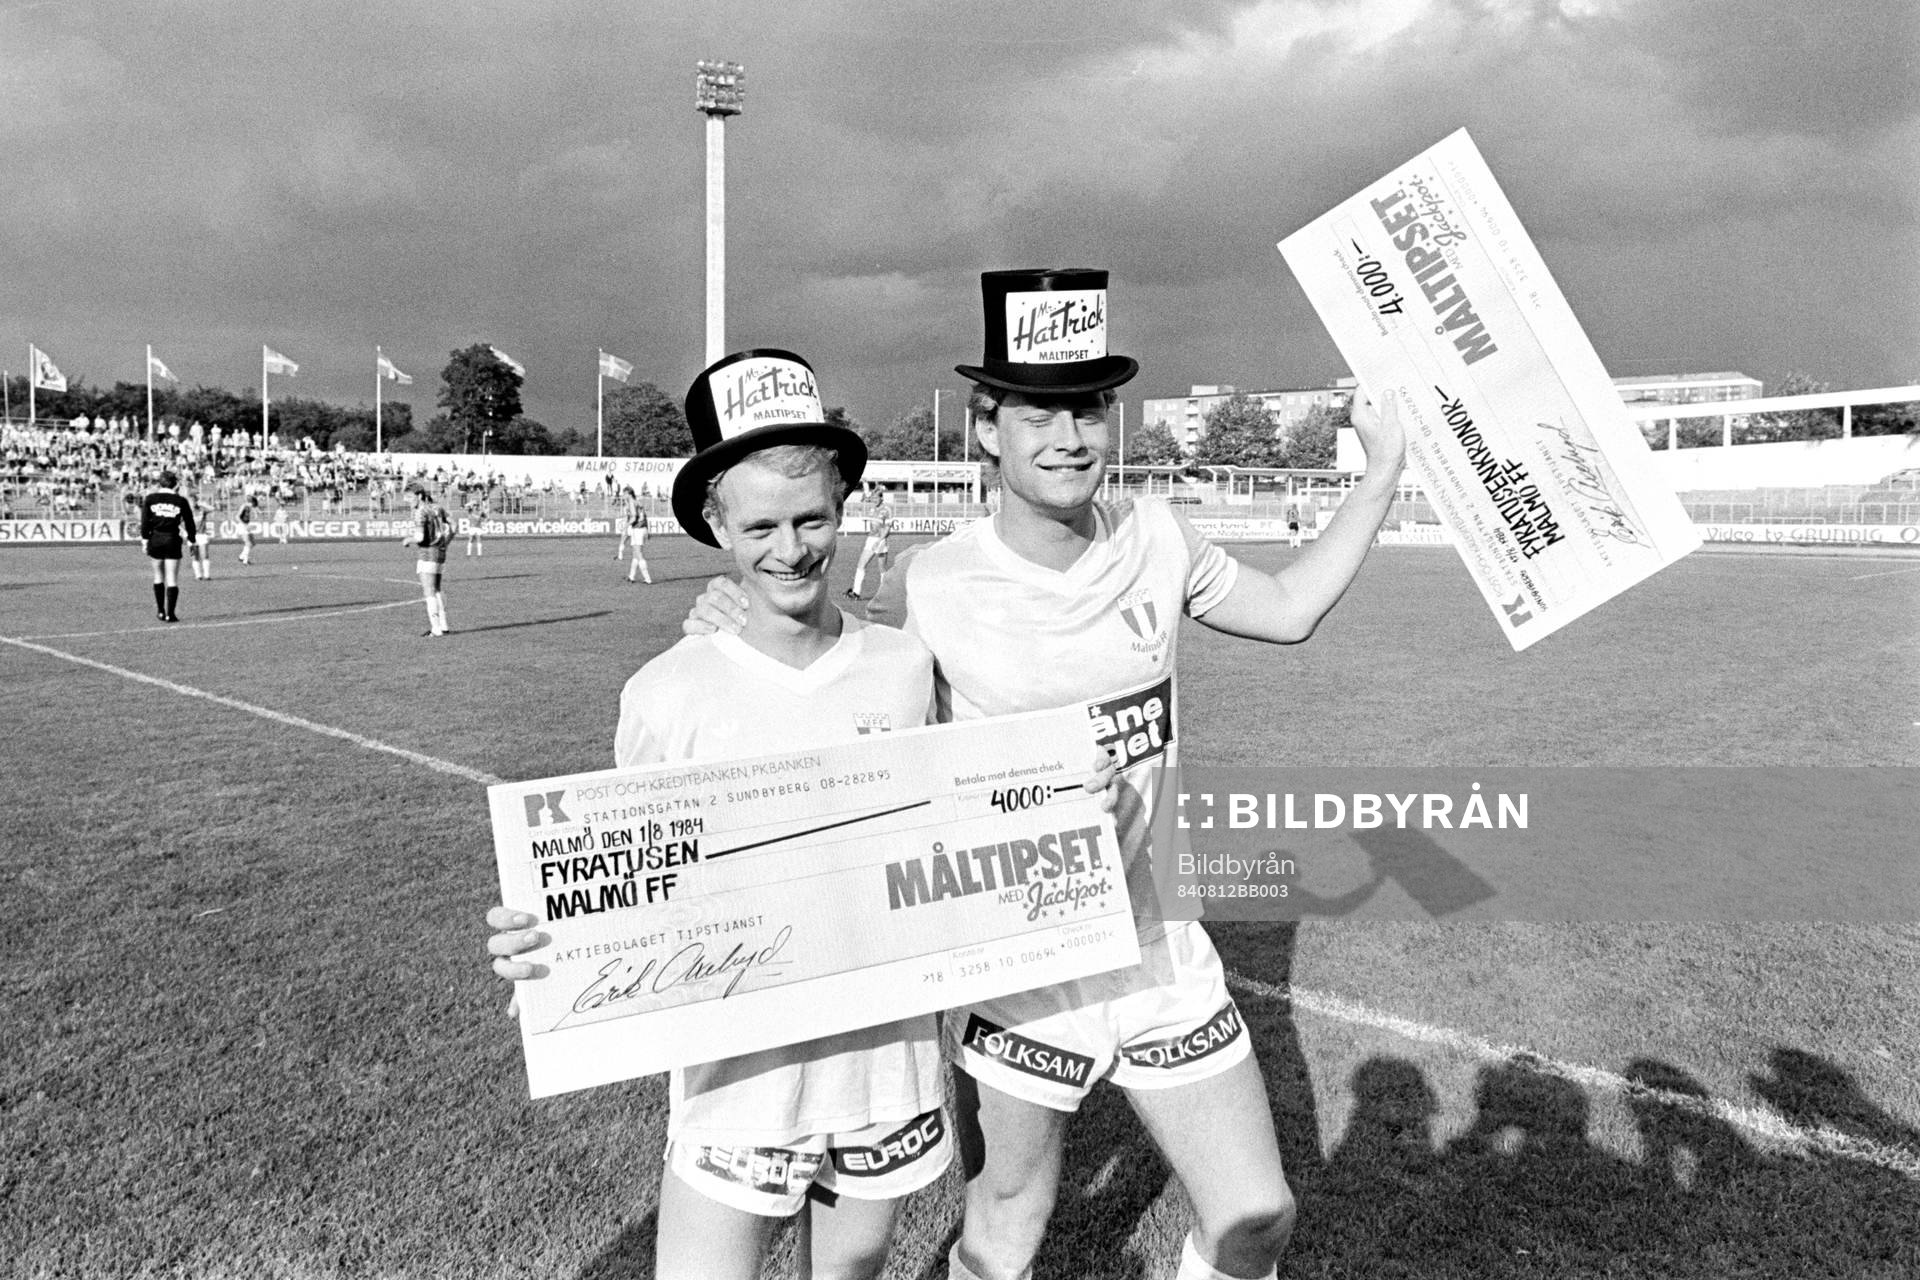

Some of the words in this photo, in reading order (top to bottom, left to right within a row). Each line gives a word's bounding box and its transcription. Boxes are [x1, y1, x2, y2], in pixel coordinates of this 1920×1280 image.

[1371, 189, 1498, 366] MÅLTIPSET
[576, 459, 617, 472] MALMÖ
[624, 461, 675, 473] STADION
[1500, 458, 1529, 485] FF
[0, 523, 112, 539] SKANDIA
[245, 520, 361, 538] PIONEER
[459, 519, 505, 535] Bsta
[915, 519, 956, 532] HANSA
[1512, 484, 1565, 546] MALMÖ
[1790, 528, 1883, 543] GRUNDIG
[1501, 593, 1532, 627] PK
[576, 784, 610, 801] POST
[614, 780, 646, 796] OCH
[751, 755, 821, 775] PKBANKEN
[954, 773, 985, 786] Betala
[987, 770, 1006, 780] mot
[1007, 767, 1038, 777] denna
[1038, 761, 1064, 773] check
[523, 790, 570, 827] PK
[583, 798, 699, 824] STATIONSGATAN
[709, 794, 716, 806] 2
[727, 782, 809, 803] SUNDBYBERG
[531, 826, 594, 858] MALMÖ
[600, 828, 632, 848] DEN
[668, 817, 703, 837] 1984
[540, 839, 698, 888] FYRATUSEN
[885, 825, 1103, 911] MÅLTIPSET
[546, 870, 638, 921] MALMÖ
[645, 872, 678, 903] FF
[998, 888, 1024, 904] MED
[1026, 876, 1107, 922] Jackpot
[555, 932, 664, 961] AKTIEBOLAGET
[973, 1025, 1086, 1081] FOLKSAM
[843, 1115, 939, 1170] EUROC
